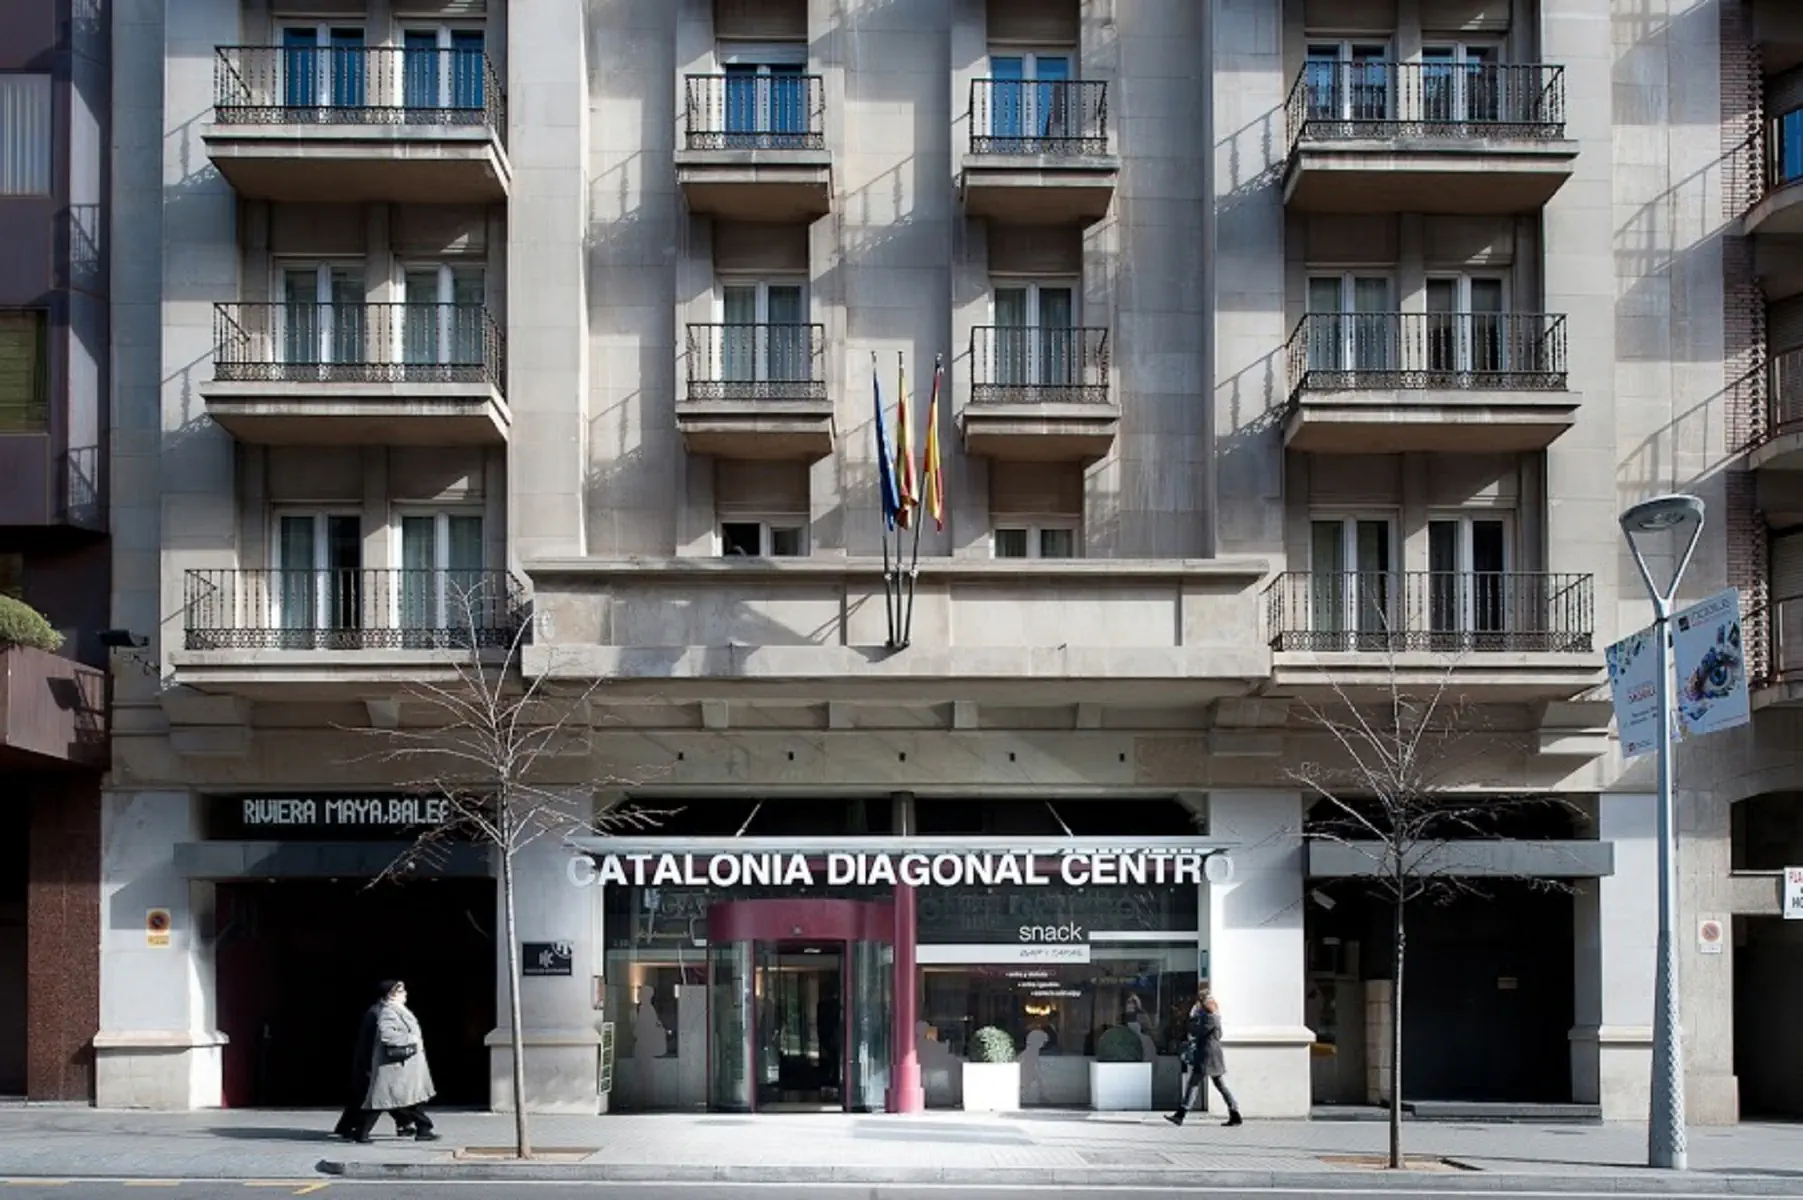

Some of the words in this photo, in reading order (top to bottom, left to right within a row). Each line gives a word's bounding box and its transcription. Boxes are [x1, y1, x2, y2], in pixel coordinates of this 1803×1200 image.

[242, 799, 316, 824] RIVIERA
[567, 853, 814, 886] CATALONIA
[827, 853, 1050, 887] DIAGONAL
[1060, 853, 1235, 886] CENTRO
[1019, 921, 1082, 941] snack
